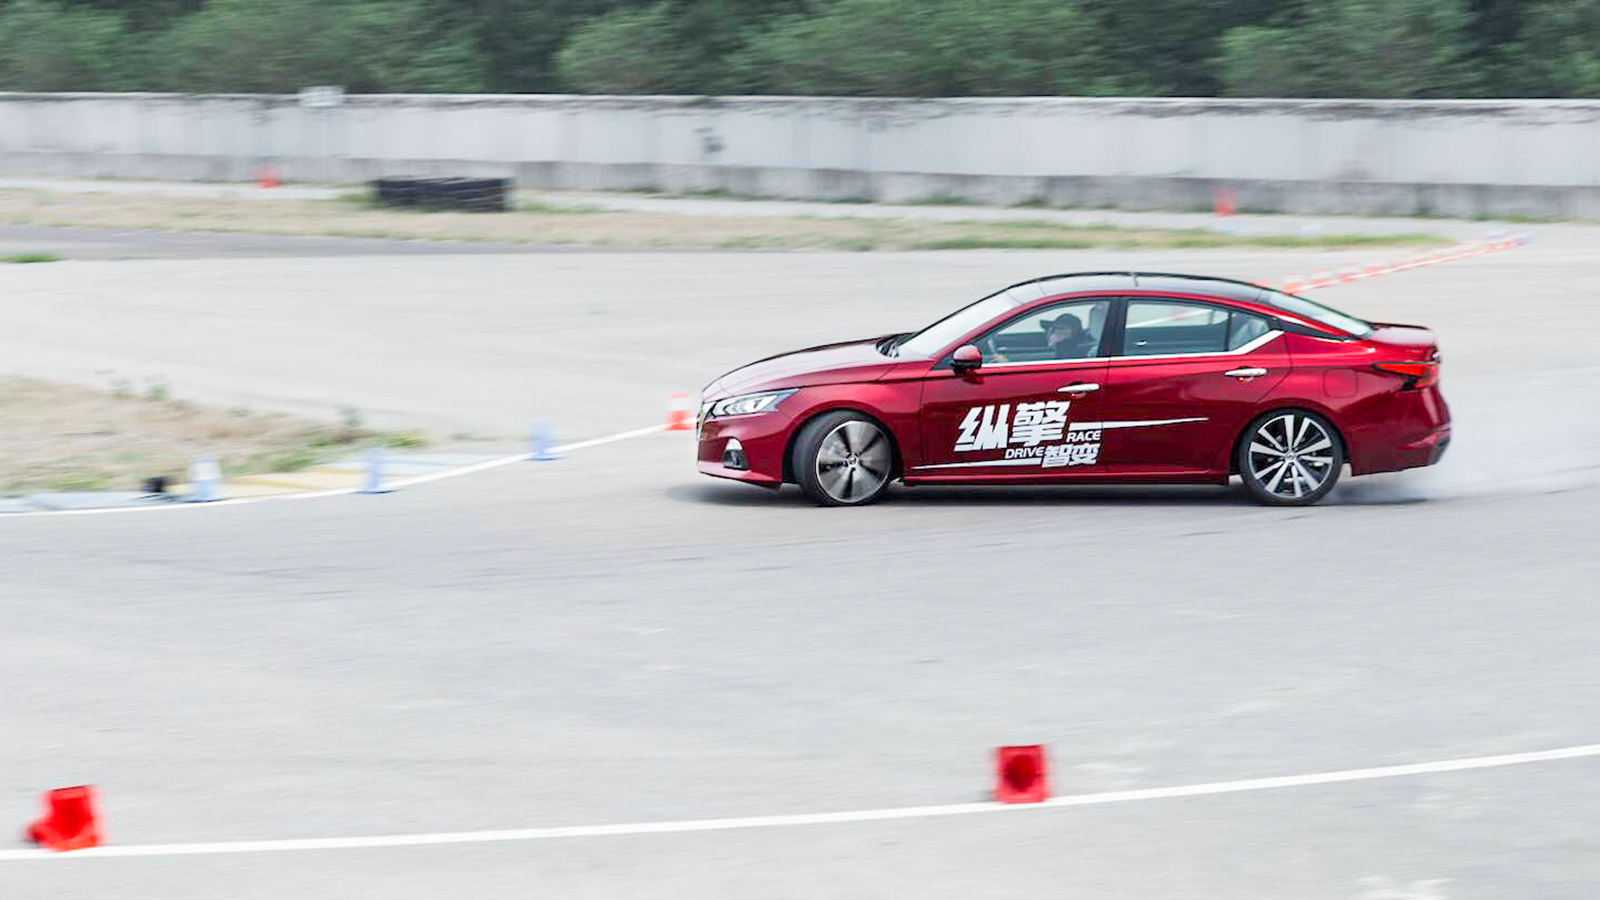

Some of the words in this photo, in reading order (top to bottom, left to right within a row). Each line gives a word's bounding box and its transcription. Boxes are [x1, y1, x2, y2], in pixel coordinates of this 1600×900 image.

[954, 400, 1071, 452] 纵擎
[1066, 430, 1101, 443] RACE
[1004, 446, 1044, 460] DRIVE
[1041, 443, 1100, 468] 智变
